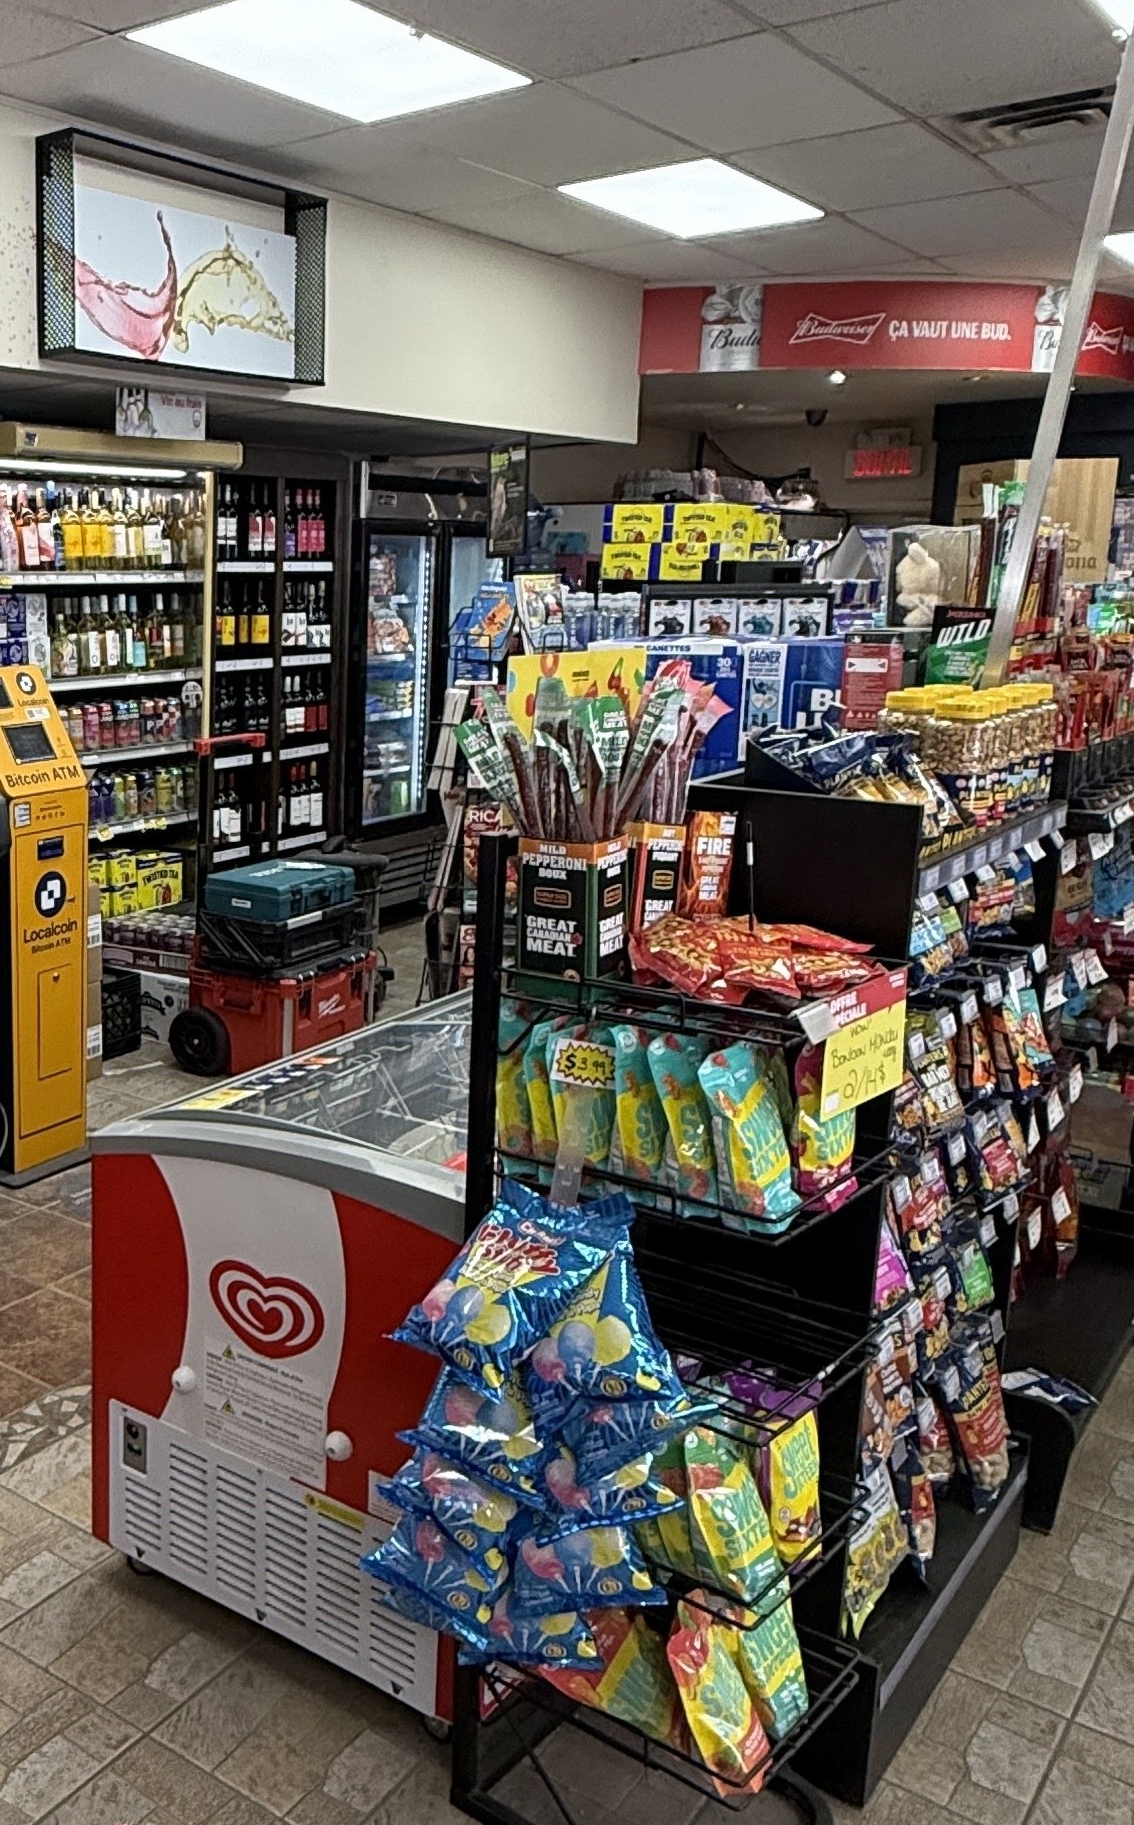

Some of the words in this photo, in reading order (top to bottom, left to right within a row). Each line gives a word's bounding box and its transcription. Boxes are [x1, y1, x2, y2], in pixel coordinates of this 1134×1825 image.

[797, 317, 880, 339] Budweiser
[889, 320, 908, 341] ÇA
[912, 320, 947, 339] VAUT
[951, 320, 978, 339] UNE
[981, 321, 1011, 340] BUD.
[936, 618, 992, 649] WILD
[5, 771, 51, 788] Bitcoin
[53, 765, 80, 782] ATM
[469, 809, 503, 823] RICA
[539, 843, 567, 855] MILD
[696, 837, 732, 856] FIRE
[522, 853, 588, 872] PEPPERONI
[24, 920, 78, 943] Localcoin
[526, 914, 578, 933] GREAT
[57, 937, 71, 949] ATM
[526, 929, 572, 944] CANADIAN
[526, 938, 577, 958] MEAT
[600, 936, 624, 958] MEAT
